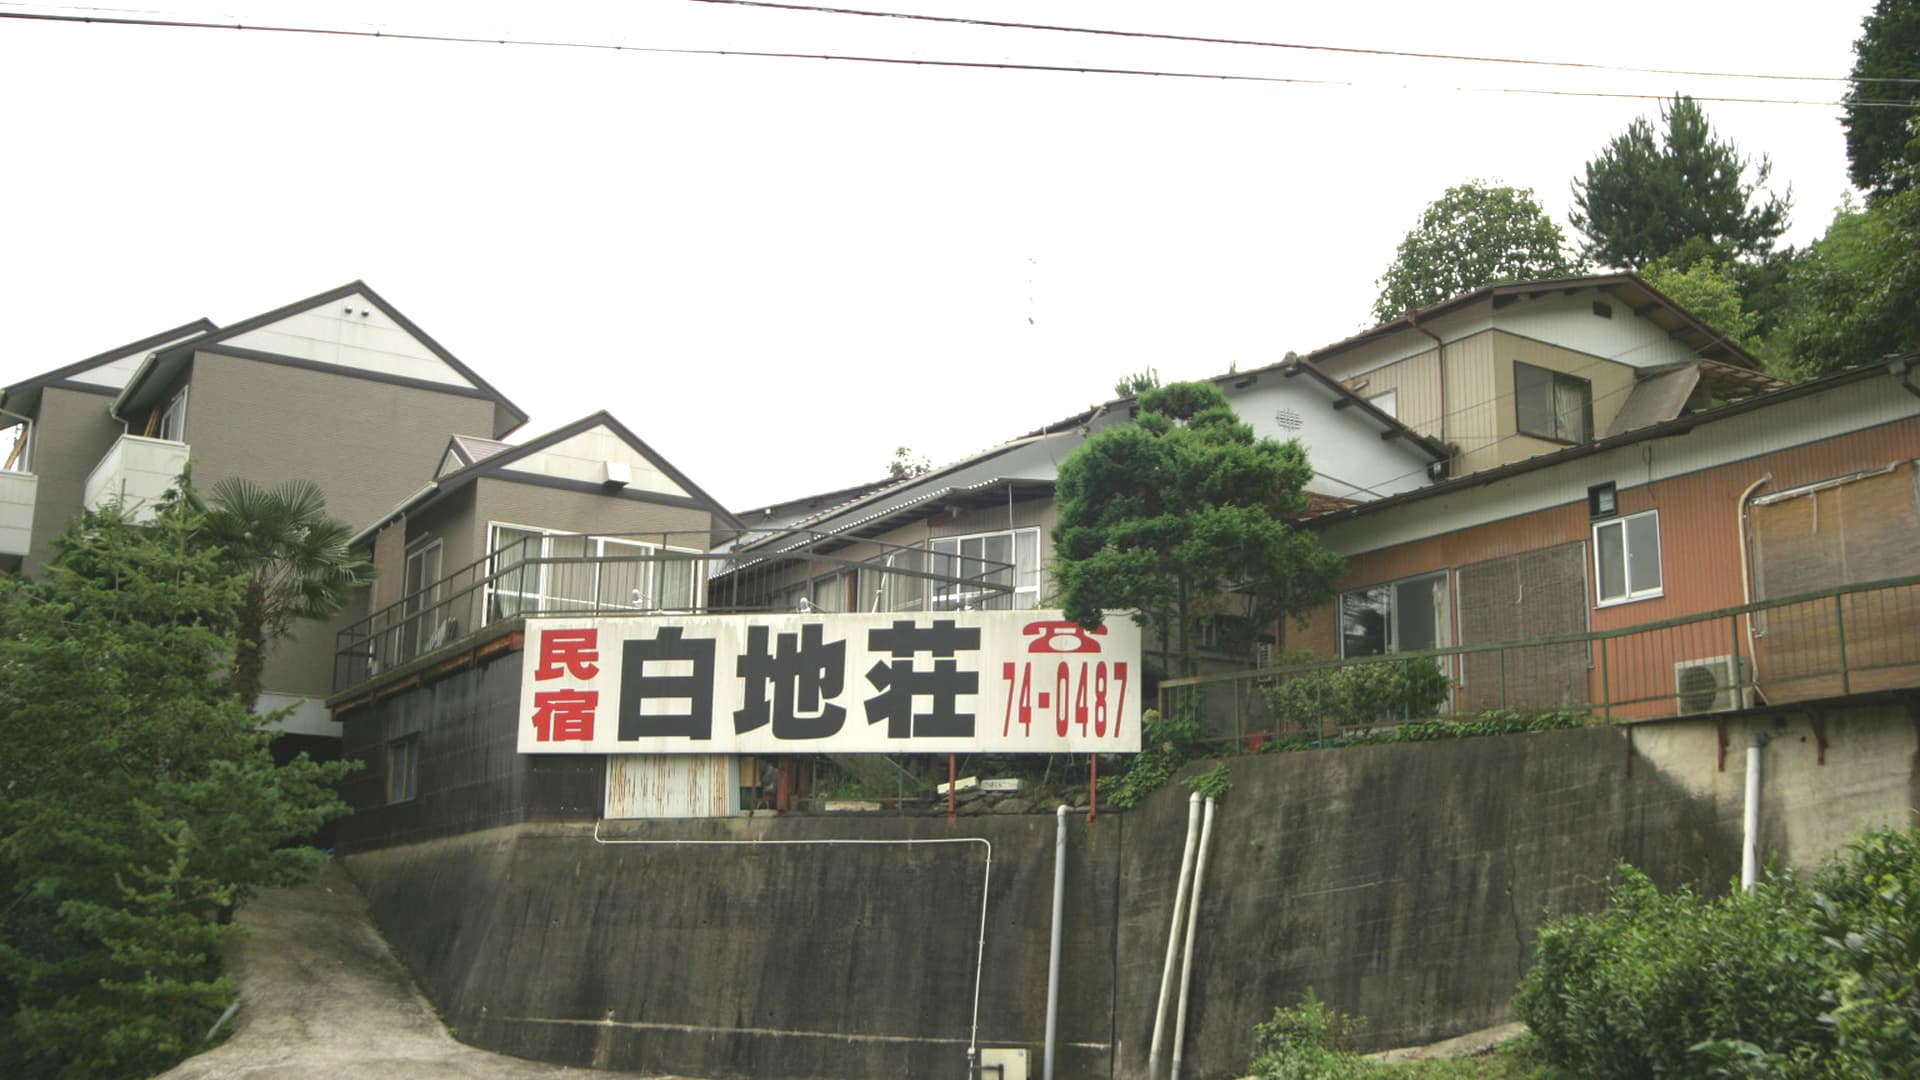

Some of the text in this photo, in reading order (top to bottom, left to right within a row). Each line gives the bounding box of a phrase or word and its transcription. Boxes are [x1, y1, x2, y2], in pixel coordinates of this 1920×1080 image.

[532, 628, 600, 742] 民宿
[617, 620, 981, 742] 白地荘
[1002, 661, 1128, 738] 74-0487
